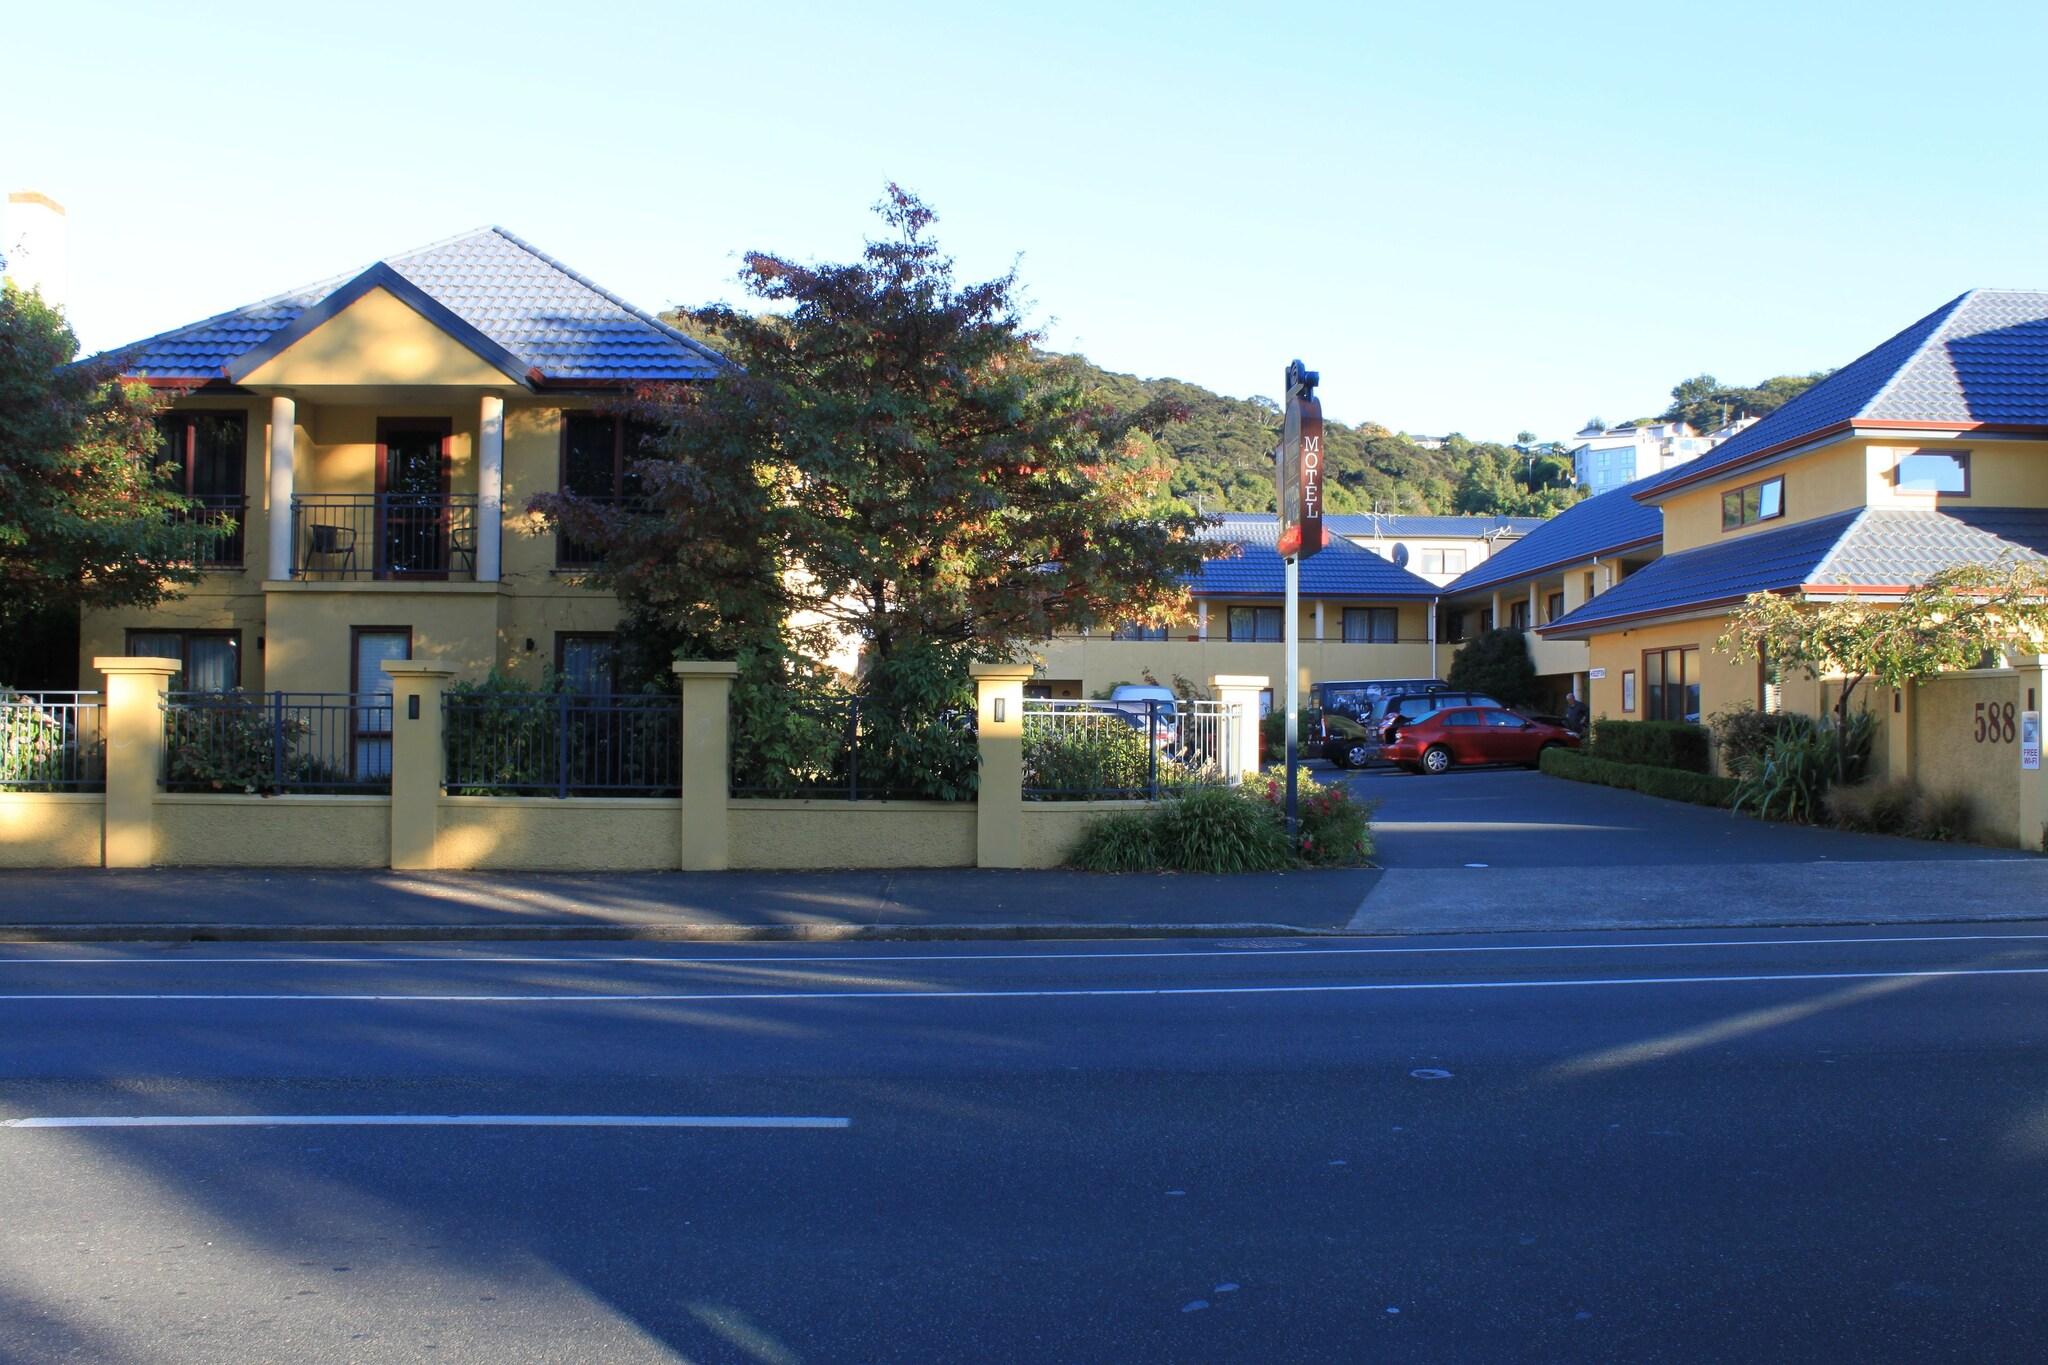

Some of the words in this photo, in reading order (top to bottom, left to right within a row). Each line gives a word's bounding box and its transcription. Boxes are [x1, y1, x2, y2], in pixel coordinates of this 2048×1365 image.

[1304, 436, 1319, 518] MOTEL
[1974, 702, 2016, 743] 588
[2023, 749, 2038, 757] FREE
